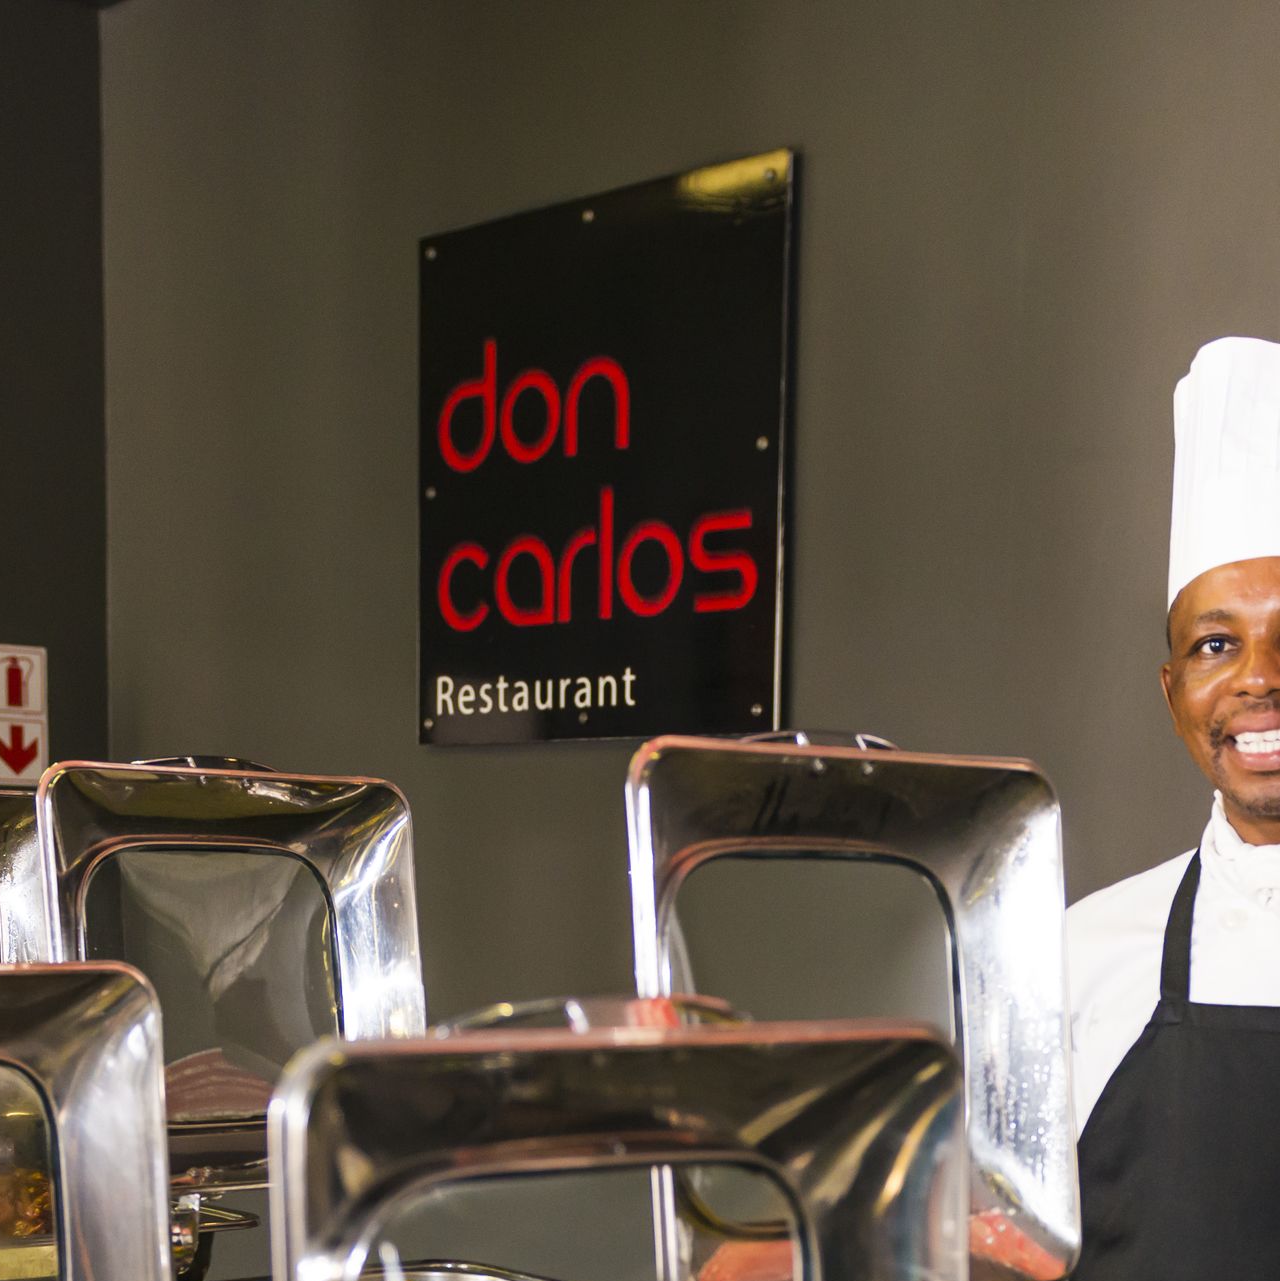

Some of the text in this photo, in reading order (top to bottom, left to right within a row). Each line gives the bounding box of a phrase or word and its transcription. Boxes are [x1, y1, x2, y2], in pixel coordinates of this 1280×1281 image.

[437, 338, 630, 473] don
[437, 485, 758, 632] carlos
[435, 666, 637, 717] Restaurant
